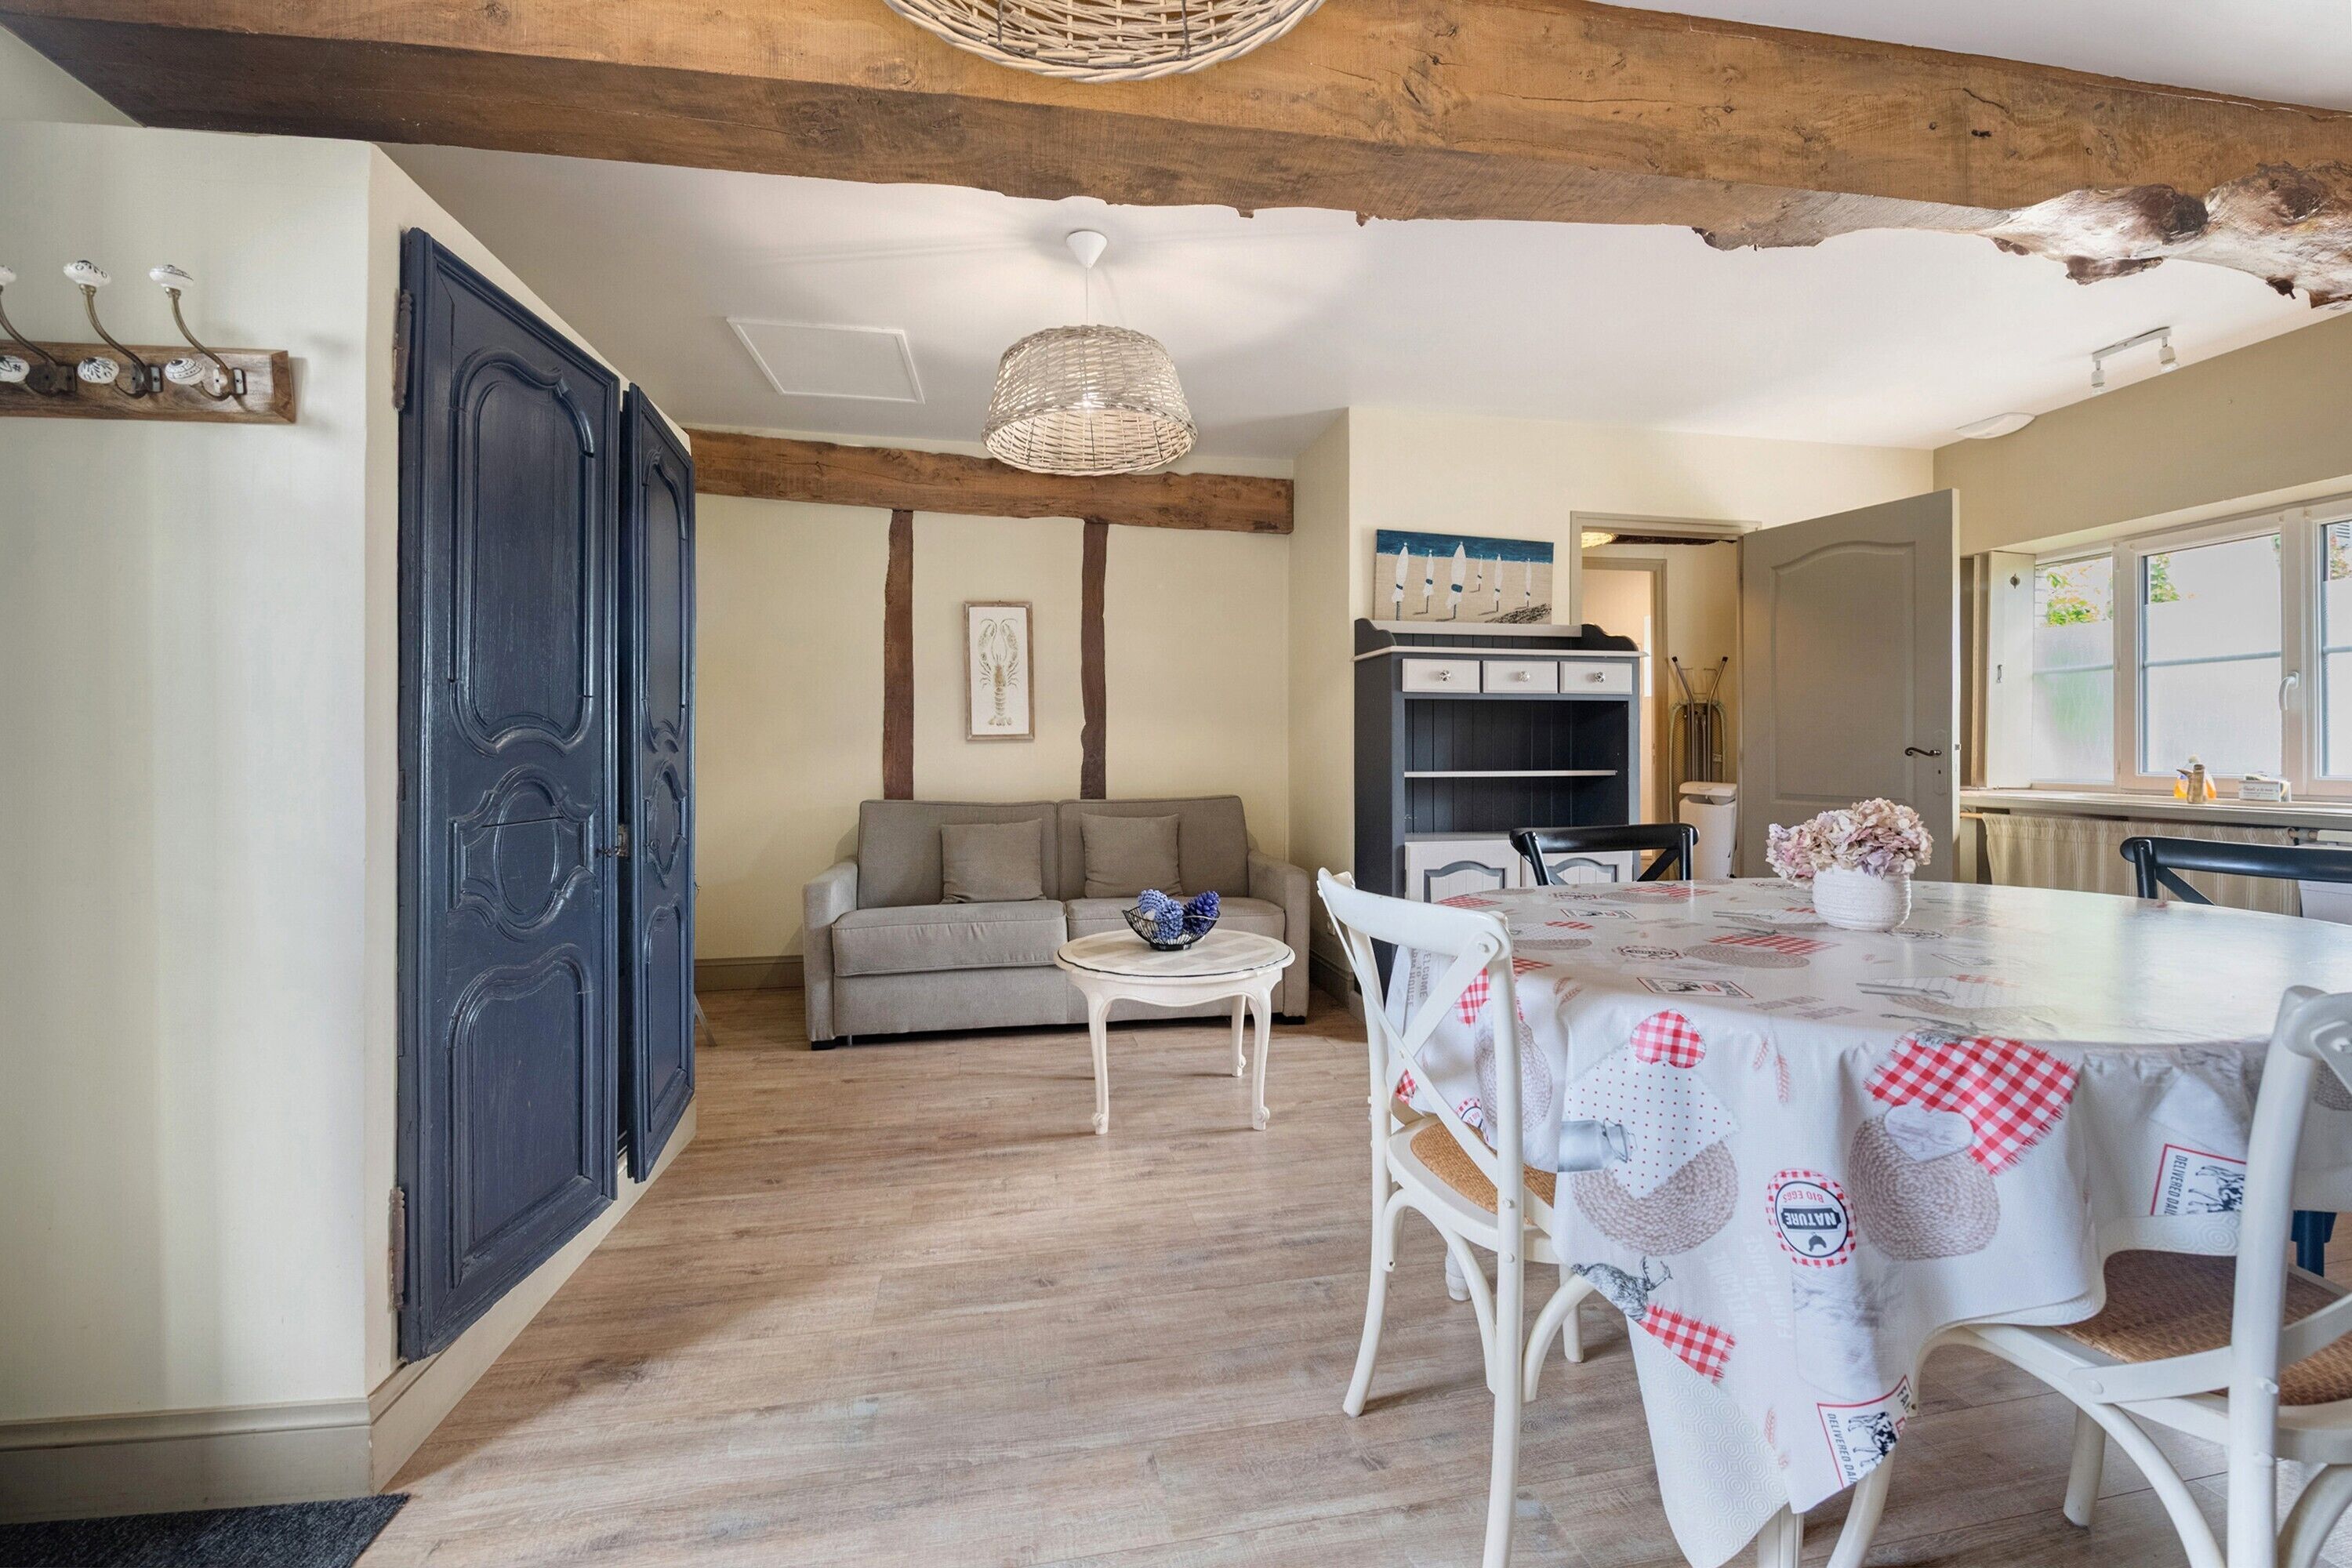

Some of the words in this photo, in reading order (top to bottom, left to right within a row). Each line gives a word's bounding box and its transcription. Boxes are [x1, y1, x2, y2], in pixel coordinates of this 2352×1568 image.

[1420, 950, 1432, 998] ELCOME
[2167, 1155, 2188, 1199] DELIVERED
[1783, 1191, 1804, 1203] EGGS
[1807, 1191, 1825, 1203] BIO
[2164, 1198, 2179, 1215] DAIL
[1785, 1211, 1837, 1226] NATURE
[1828, 1413, 1851, 1462] DELIVERED
[1844, 1464, 1858, 1484] DAI
